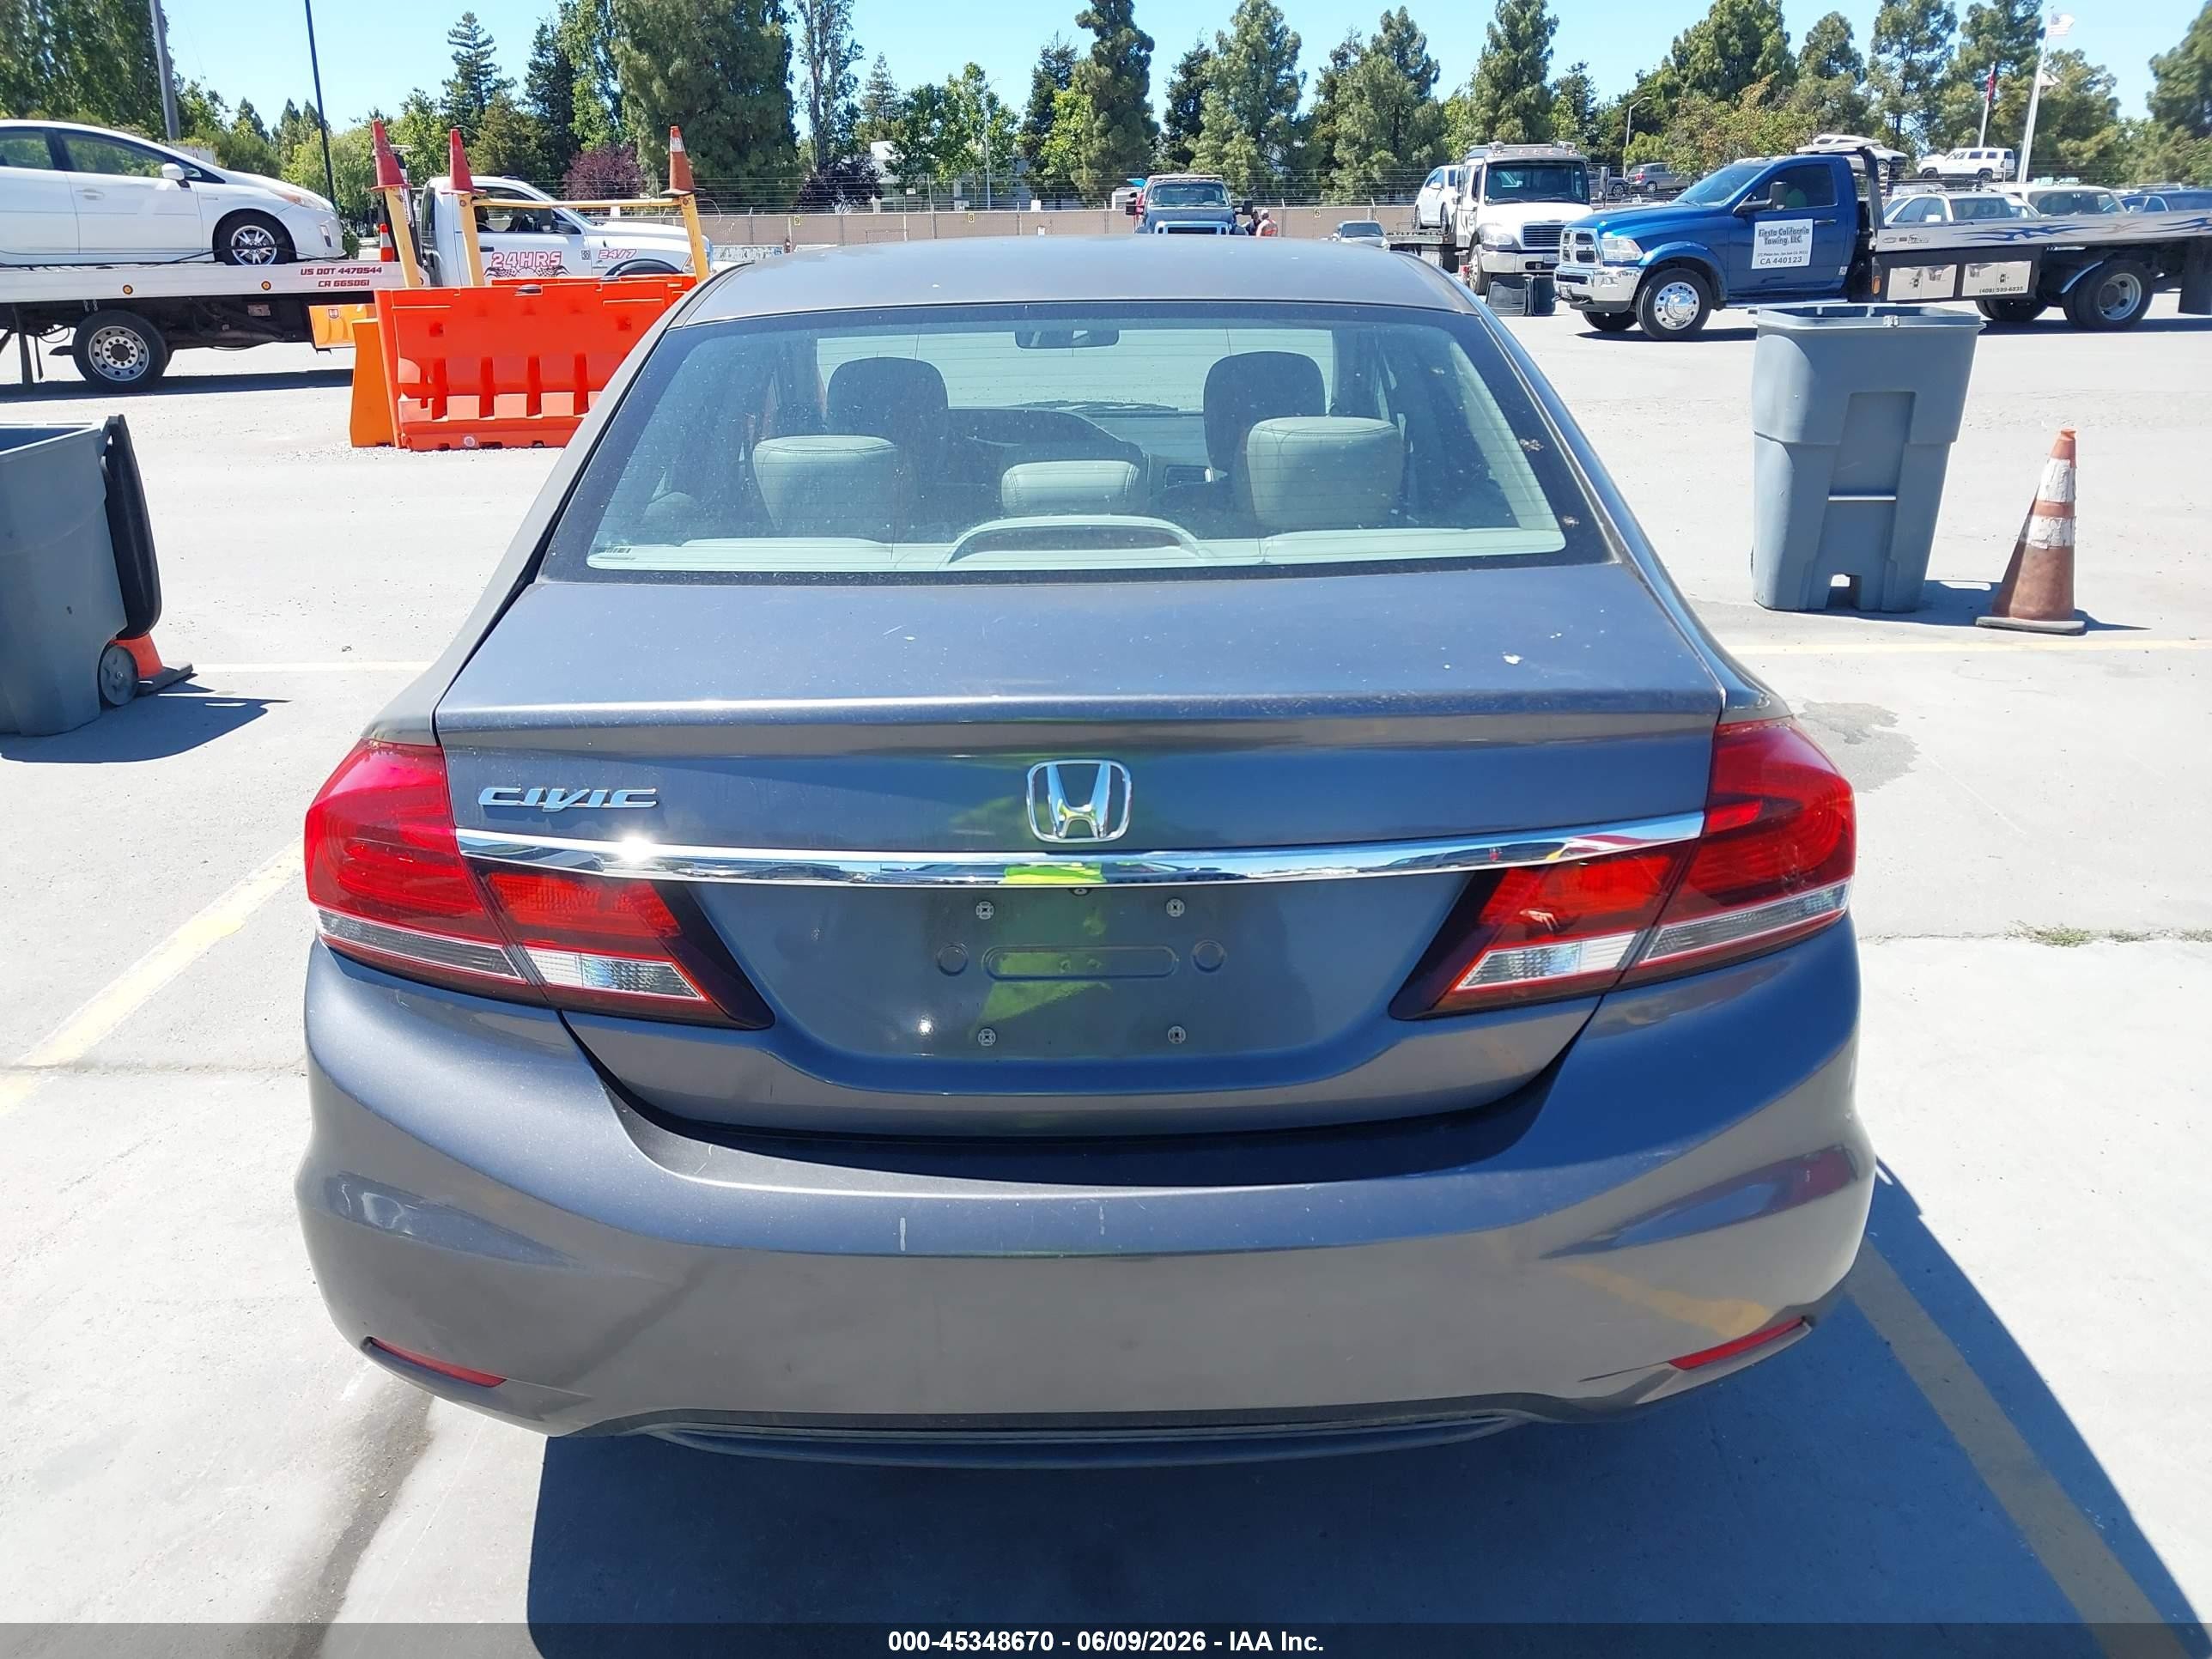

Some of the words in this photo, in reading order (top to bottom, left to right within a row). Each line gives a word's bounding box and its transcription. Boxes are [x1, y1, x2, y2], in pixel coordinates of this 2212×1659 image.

[1778, 226, 1809, 236] California
[491, 251, 562, 269] 24HRS
[599, 249, 636, 260] 24/7
[478, 787, 657, 812] CIVIC
